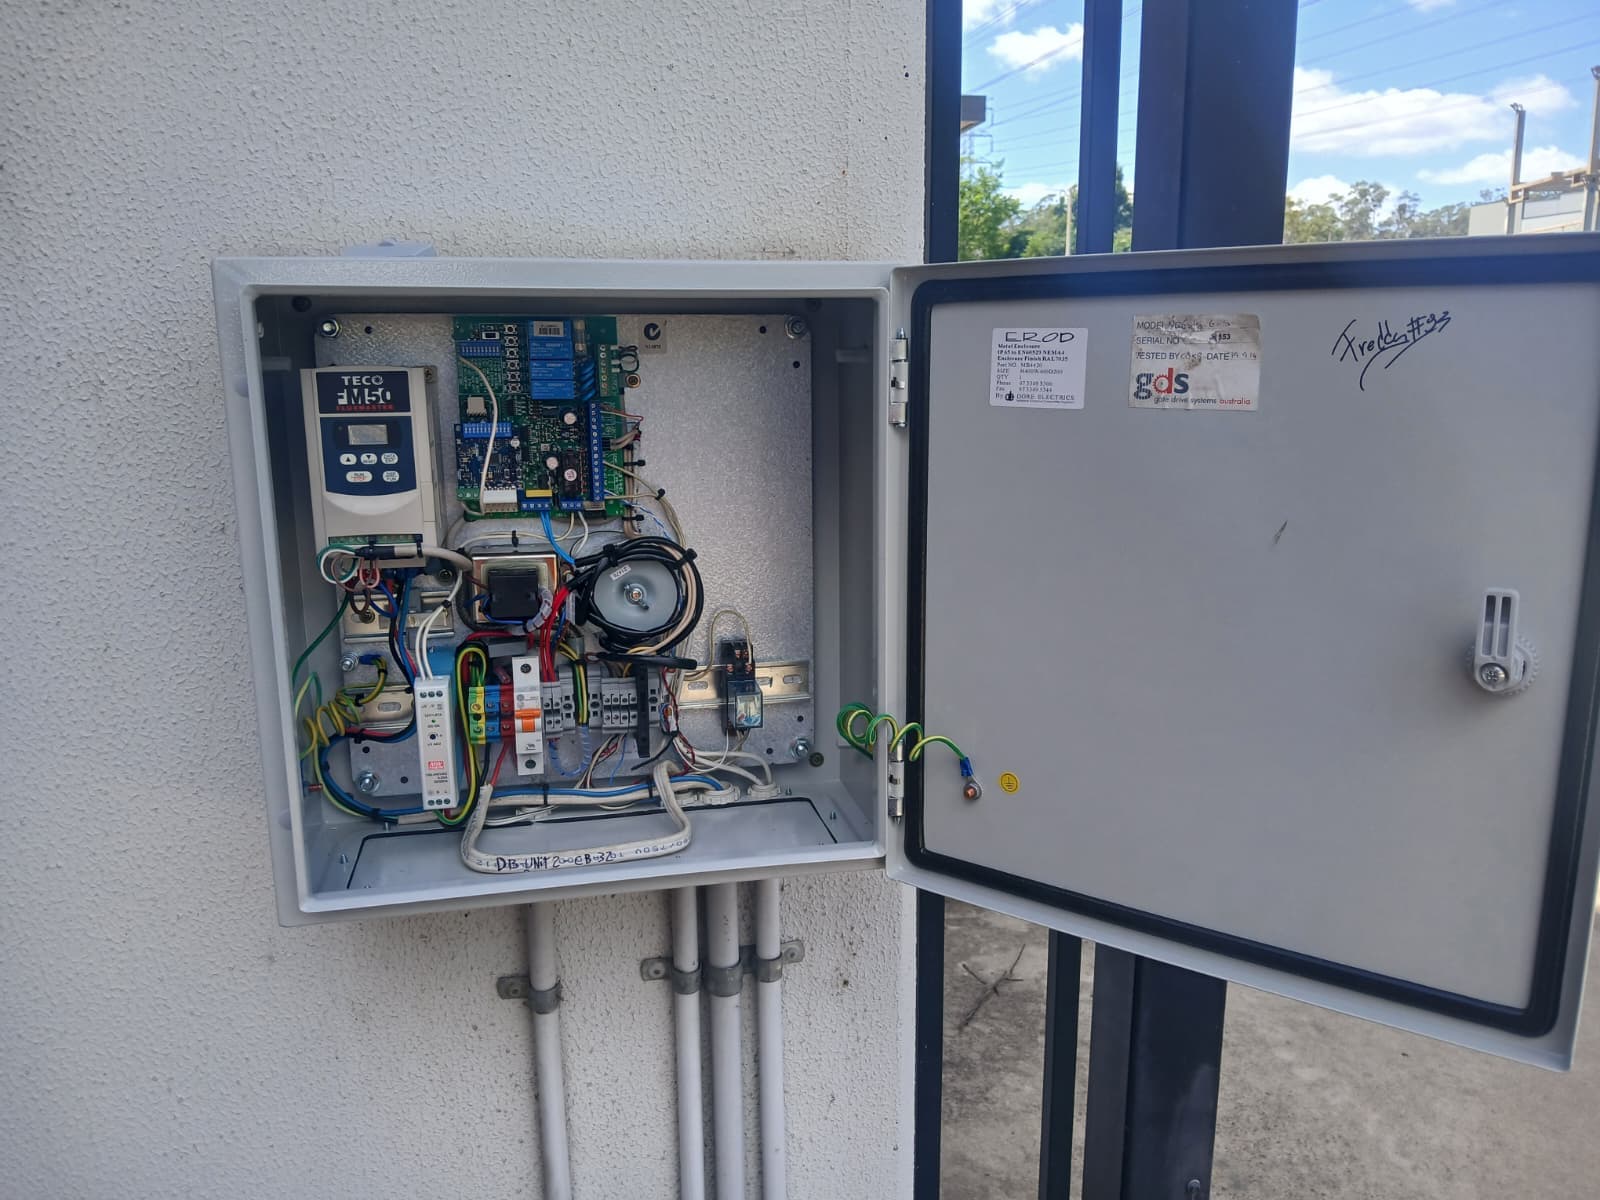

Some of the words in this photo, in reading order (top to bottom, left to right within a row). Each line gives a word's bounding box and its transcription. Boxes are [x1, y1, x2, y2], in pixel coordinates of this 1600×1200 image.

[1136, 320, 1164, 330] MODEL
[1005, 331, 1075, 343] EROD
[1136, 336, 1164, 345] SERIAL
[1169, 351, 1180, 360] BY
[1206, 352, 1230, 360] DATE
[341, 375, 385, 386] TECO
[1134, 368, 1190, 400] gds
[1219, 397, 1251, 405] australia
